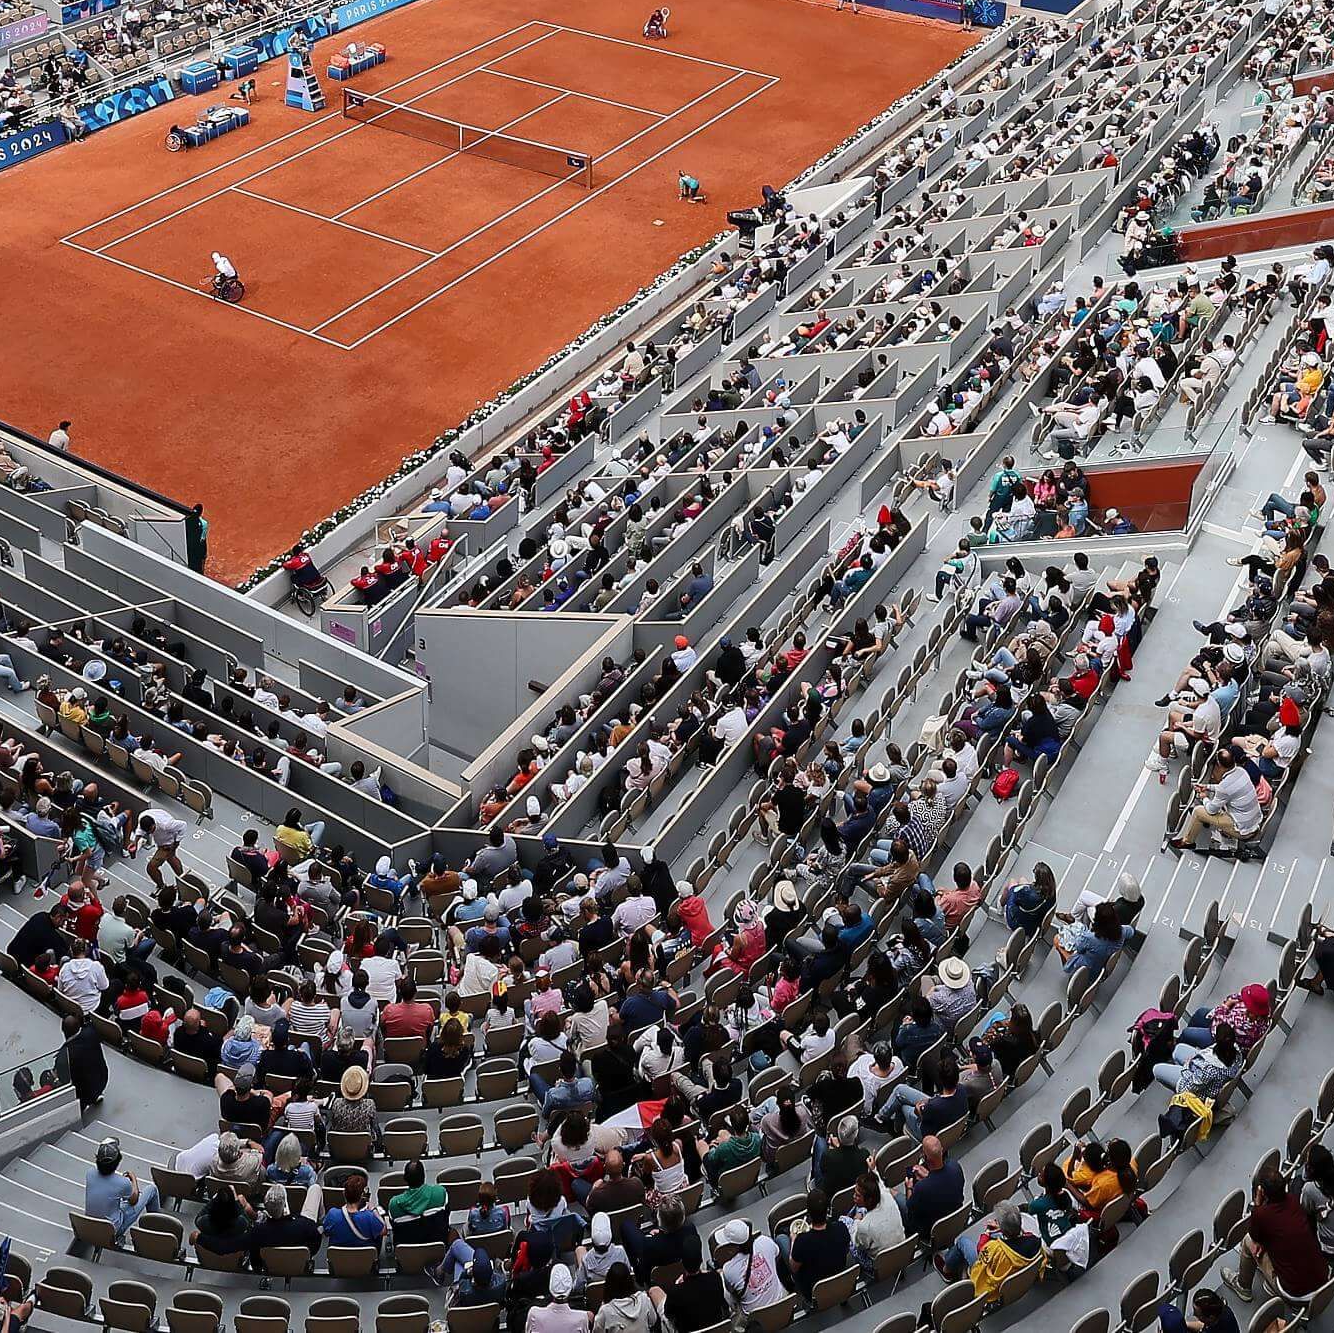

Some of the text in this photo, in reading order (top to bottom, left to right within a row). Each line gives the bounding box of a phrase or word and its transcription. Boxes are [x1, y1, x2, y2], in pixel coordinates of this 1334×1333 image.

[346, 0, 377, 21] PARIS
[14, 21, 42, 36] 2024
[10, 130, 52, 156] 2024
[1106, 859, 1118, 869] 11
[1186, 859, 1200, 871] 12
[1272, 862, 1286, 874] 13
